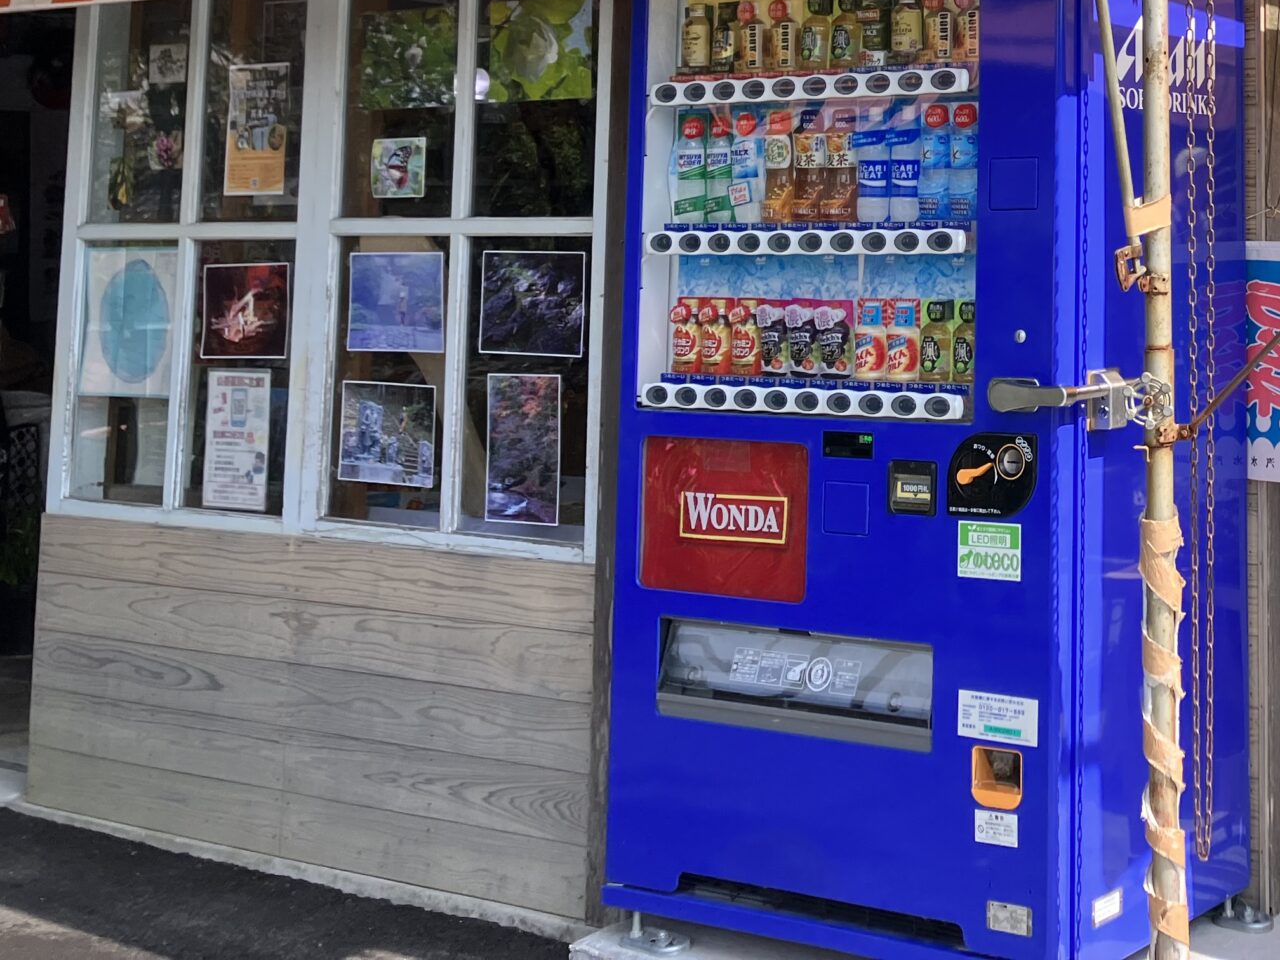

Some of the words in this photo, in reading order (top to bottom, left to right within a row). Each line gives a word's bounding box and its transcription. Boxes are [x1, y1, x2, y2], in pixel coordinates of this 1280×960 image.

[1116, 15, 1216, 90] Aahi
[1168, 92, 1216, 115] RINKS
[685, 491, 779, 533] WONDA
[971, 534, 1008, 546] LED照明
